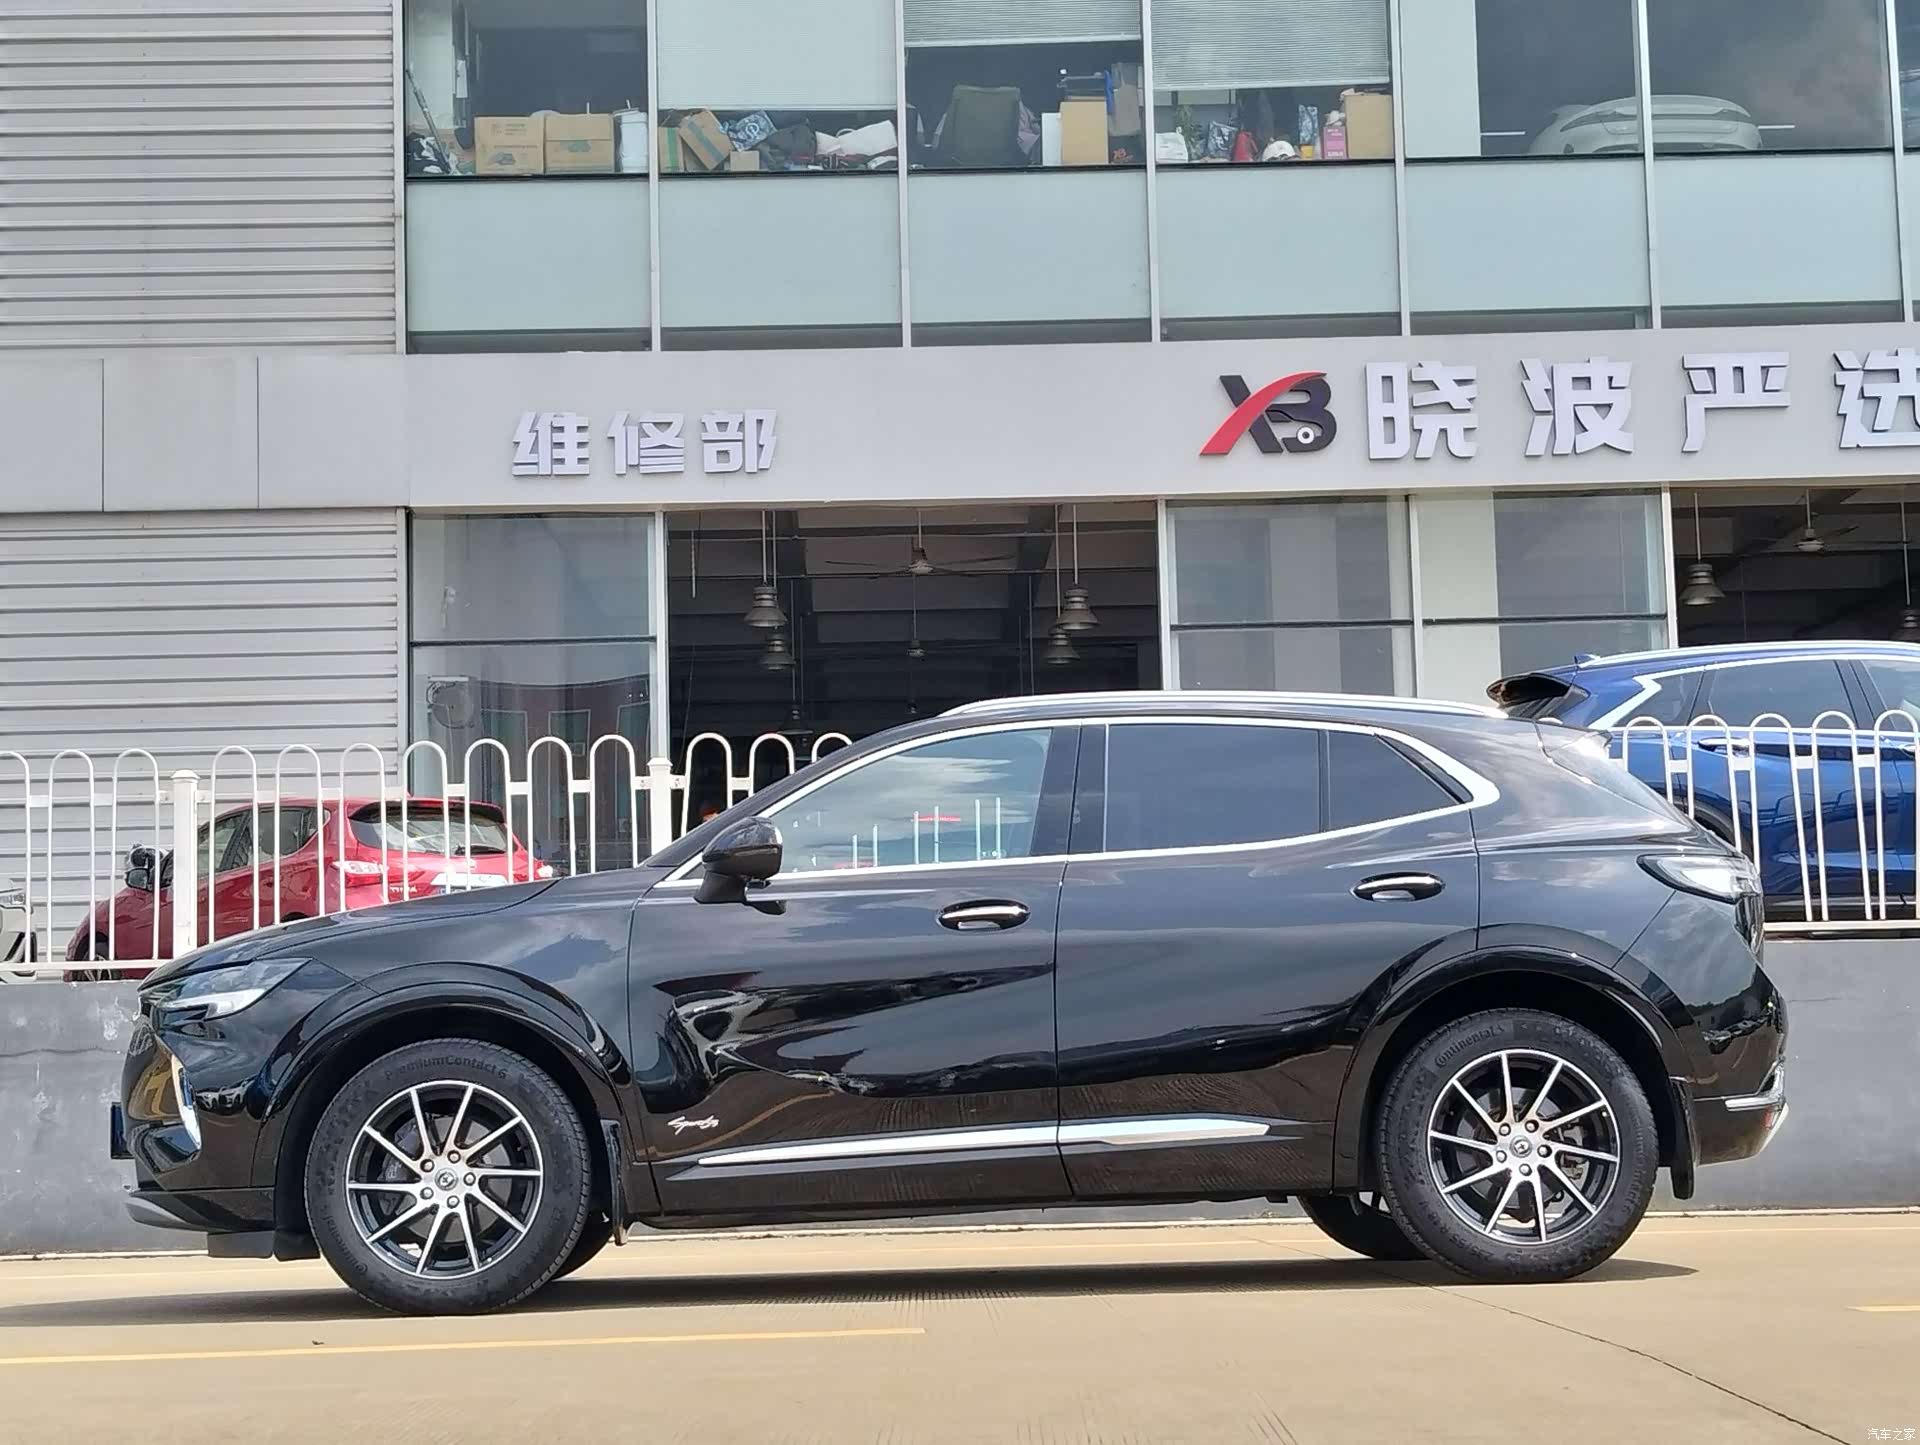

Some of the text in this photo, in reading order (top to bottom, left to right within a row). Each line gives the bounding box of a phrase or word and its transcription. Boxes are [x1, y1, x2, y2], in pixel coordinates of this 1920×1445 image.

[1365, 346, 1920, 460] 晓波严选
[511, 409, 777, 476] 维修部
[384, 1055, 497, 1080] PemiumContact
